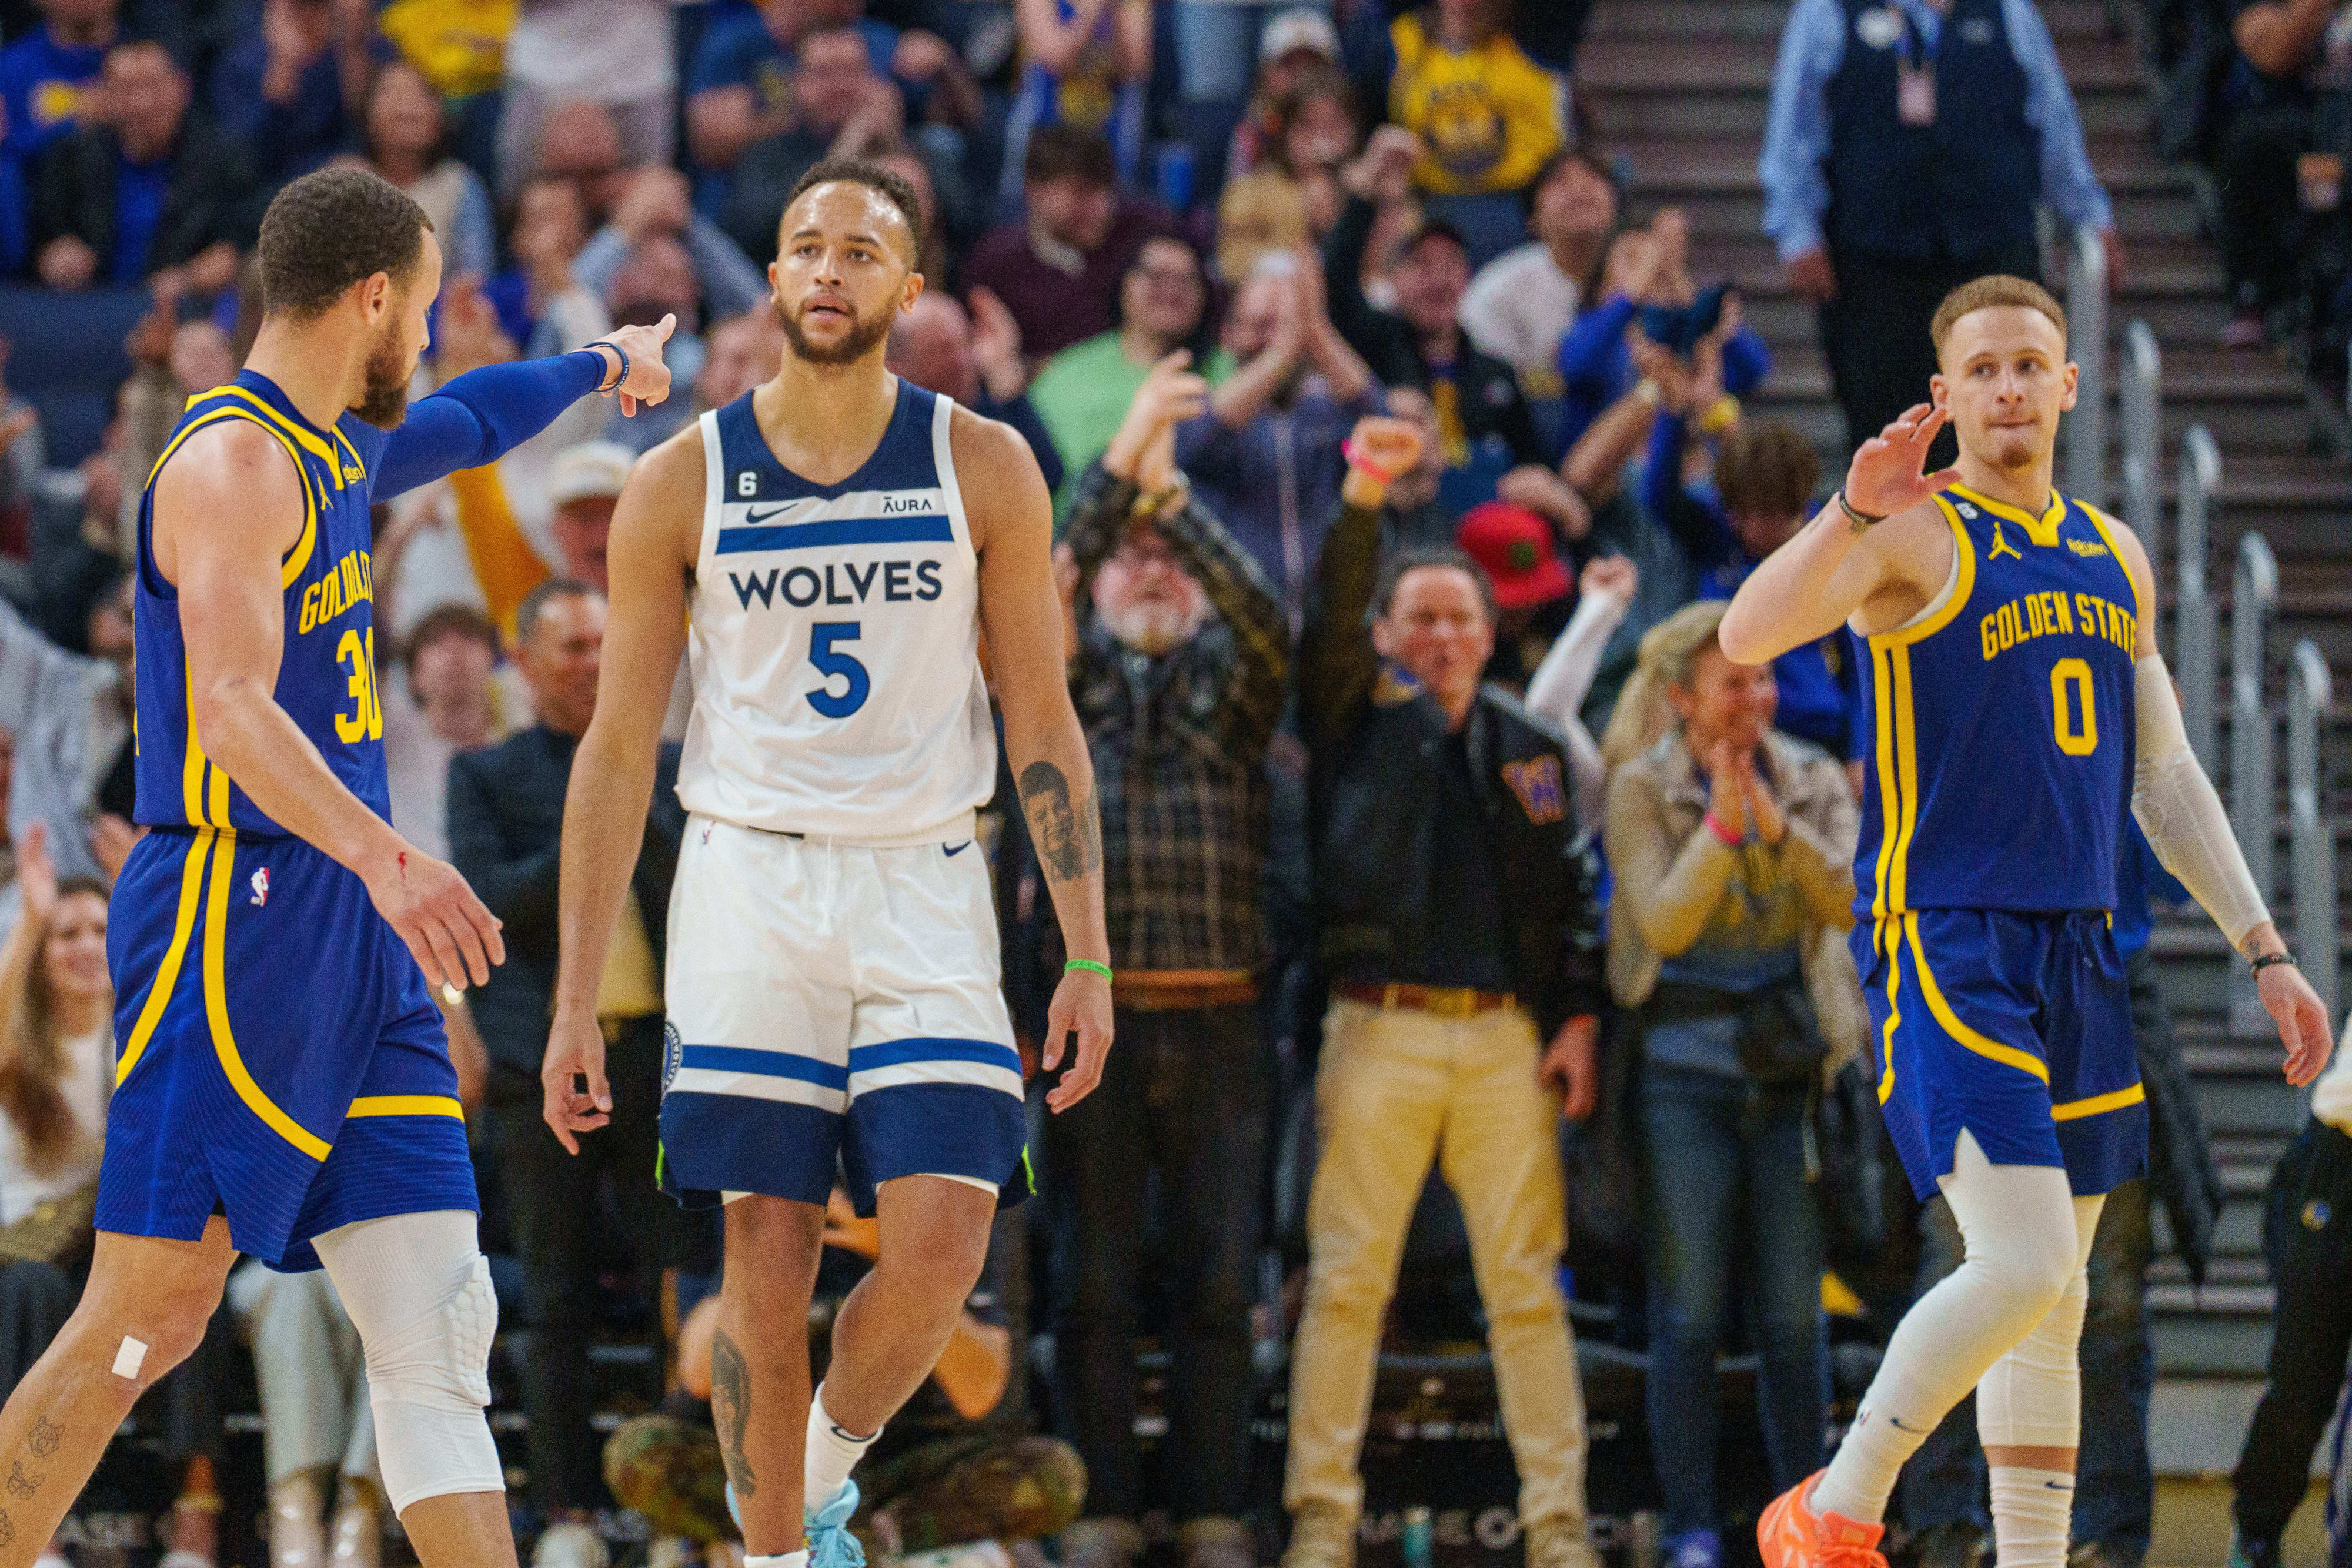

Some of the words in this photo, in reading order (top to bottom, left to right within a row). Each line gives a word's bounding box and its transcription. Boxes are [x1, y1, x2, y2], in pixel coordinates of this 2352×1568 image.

[739, 471, 757, 497] 6
[728, 559, 943, 612] WOLVES
[1980, 591, 2074, 661] GOLDEN
[334, 626, 383, 744] 30
[804, 620, 871, 720] 5
[2050, 657, 2099, 757] 0
